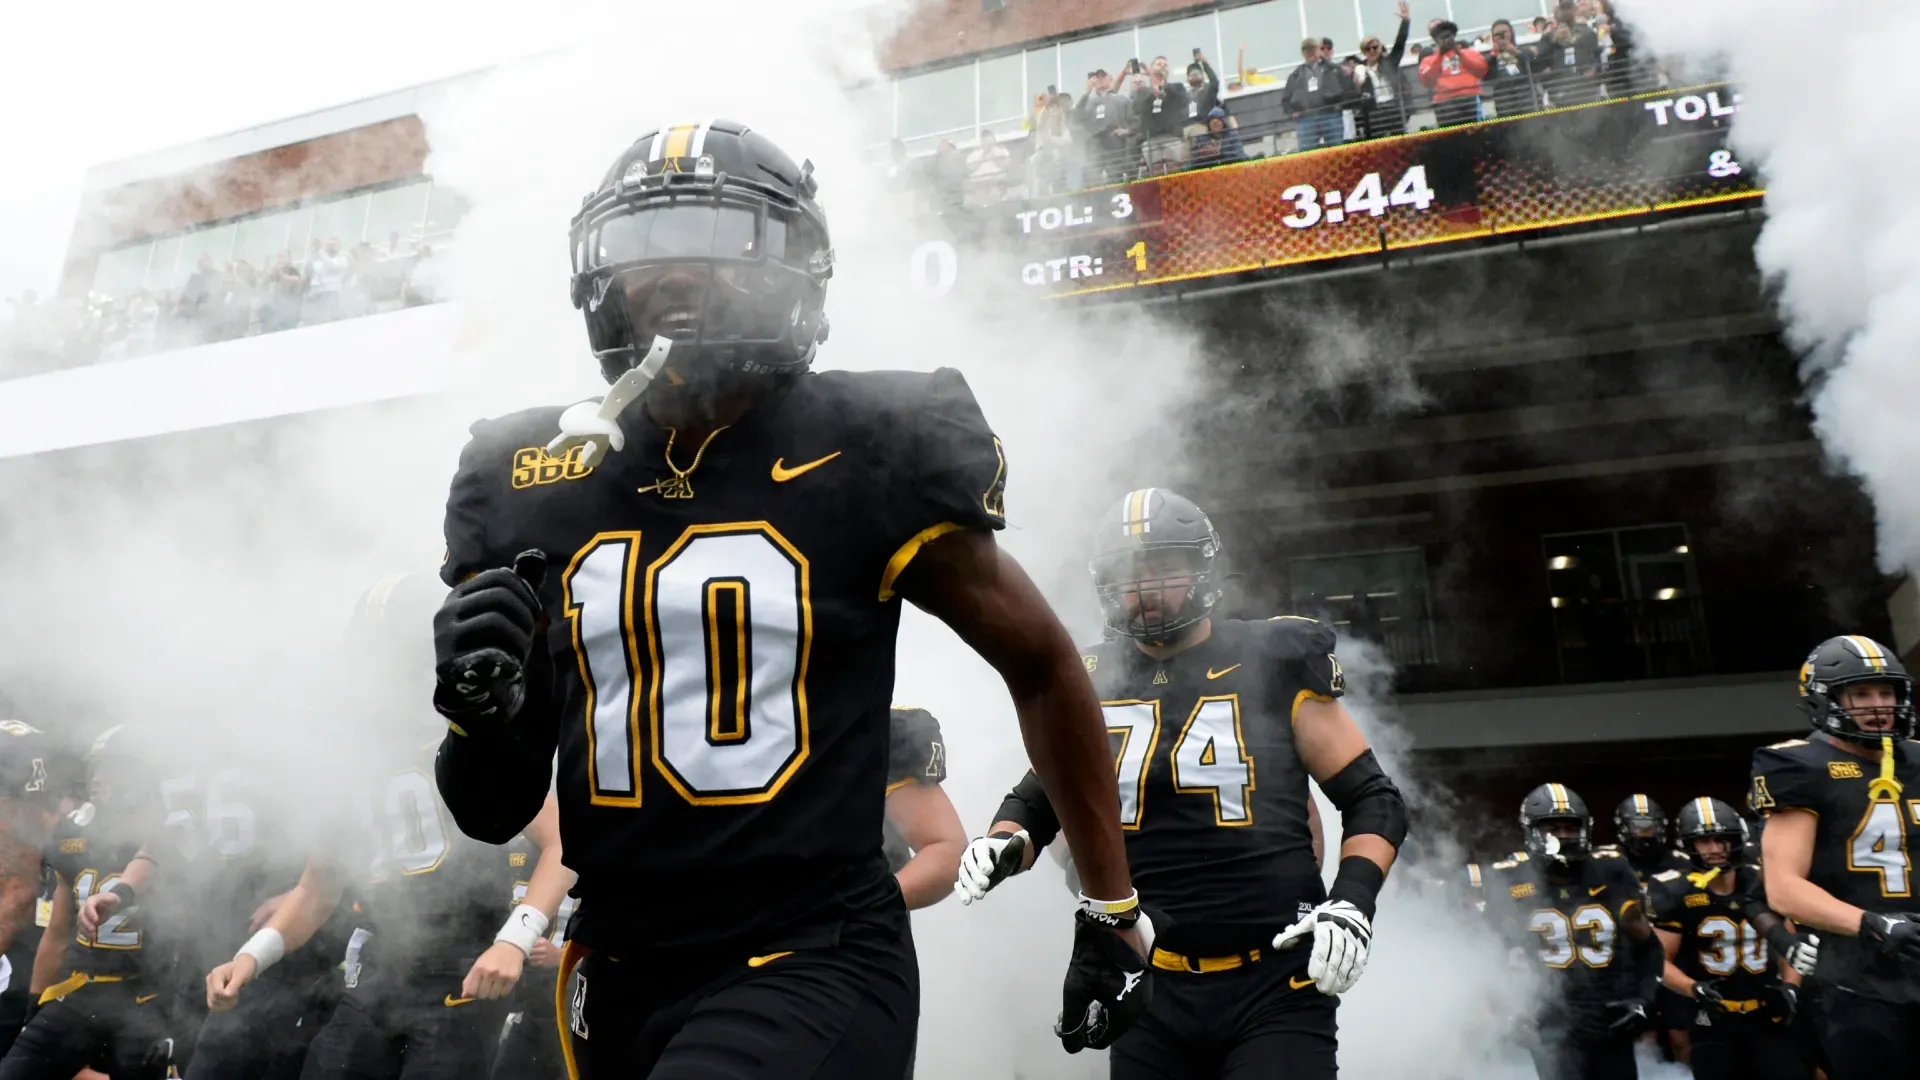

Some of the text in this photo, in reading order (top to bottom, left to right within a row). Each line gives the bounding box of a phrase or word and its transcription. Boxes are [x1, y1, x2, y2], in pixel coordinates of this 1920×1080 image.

[1707, 150, 1741, 177] &
[1016, 193, 1133, 233] TOL: 3
[1281, 165, 1434, 229] 3:44
[909, 240, 957, 299] 0
[1022, 241, 1147, 286] QTR: 1
[562, 520, 813, 808] 10
[1100, 693, 1256, 831] 74
[73, 868, 142, 949] 12
[1529, 903, 1616, 969] 33
[1697, 914, 1768, 976] 30
